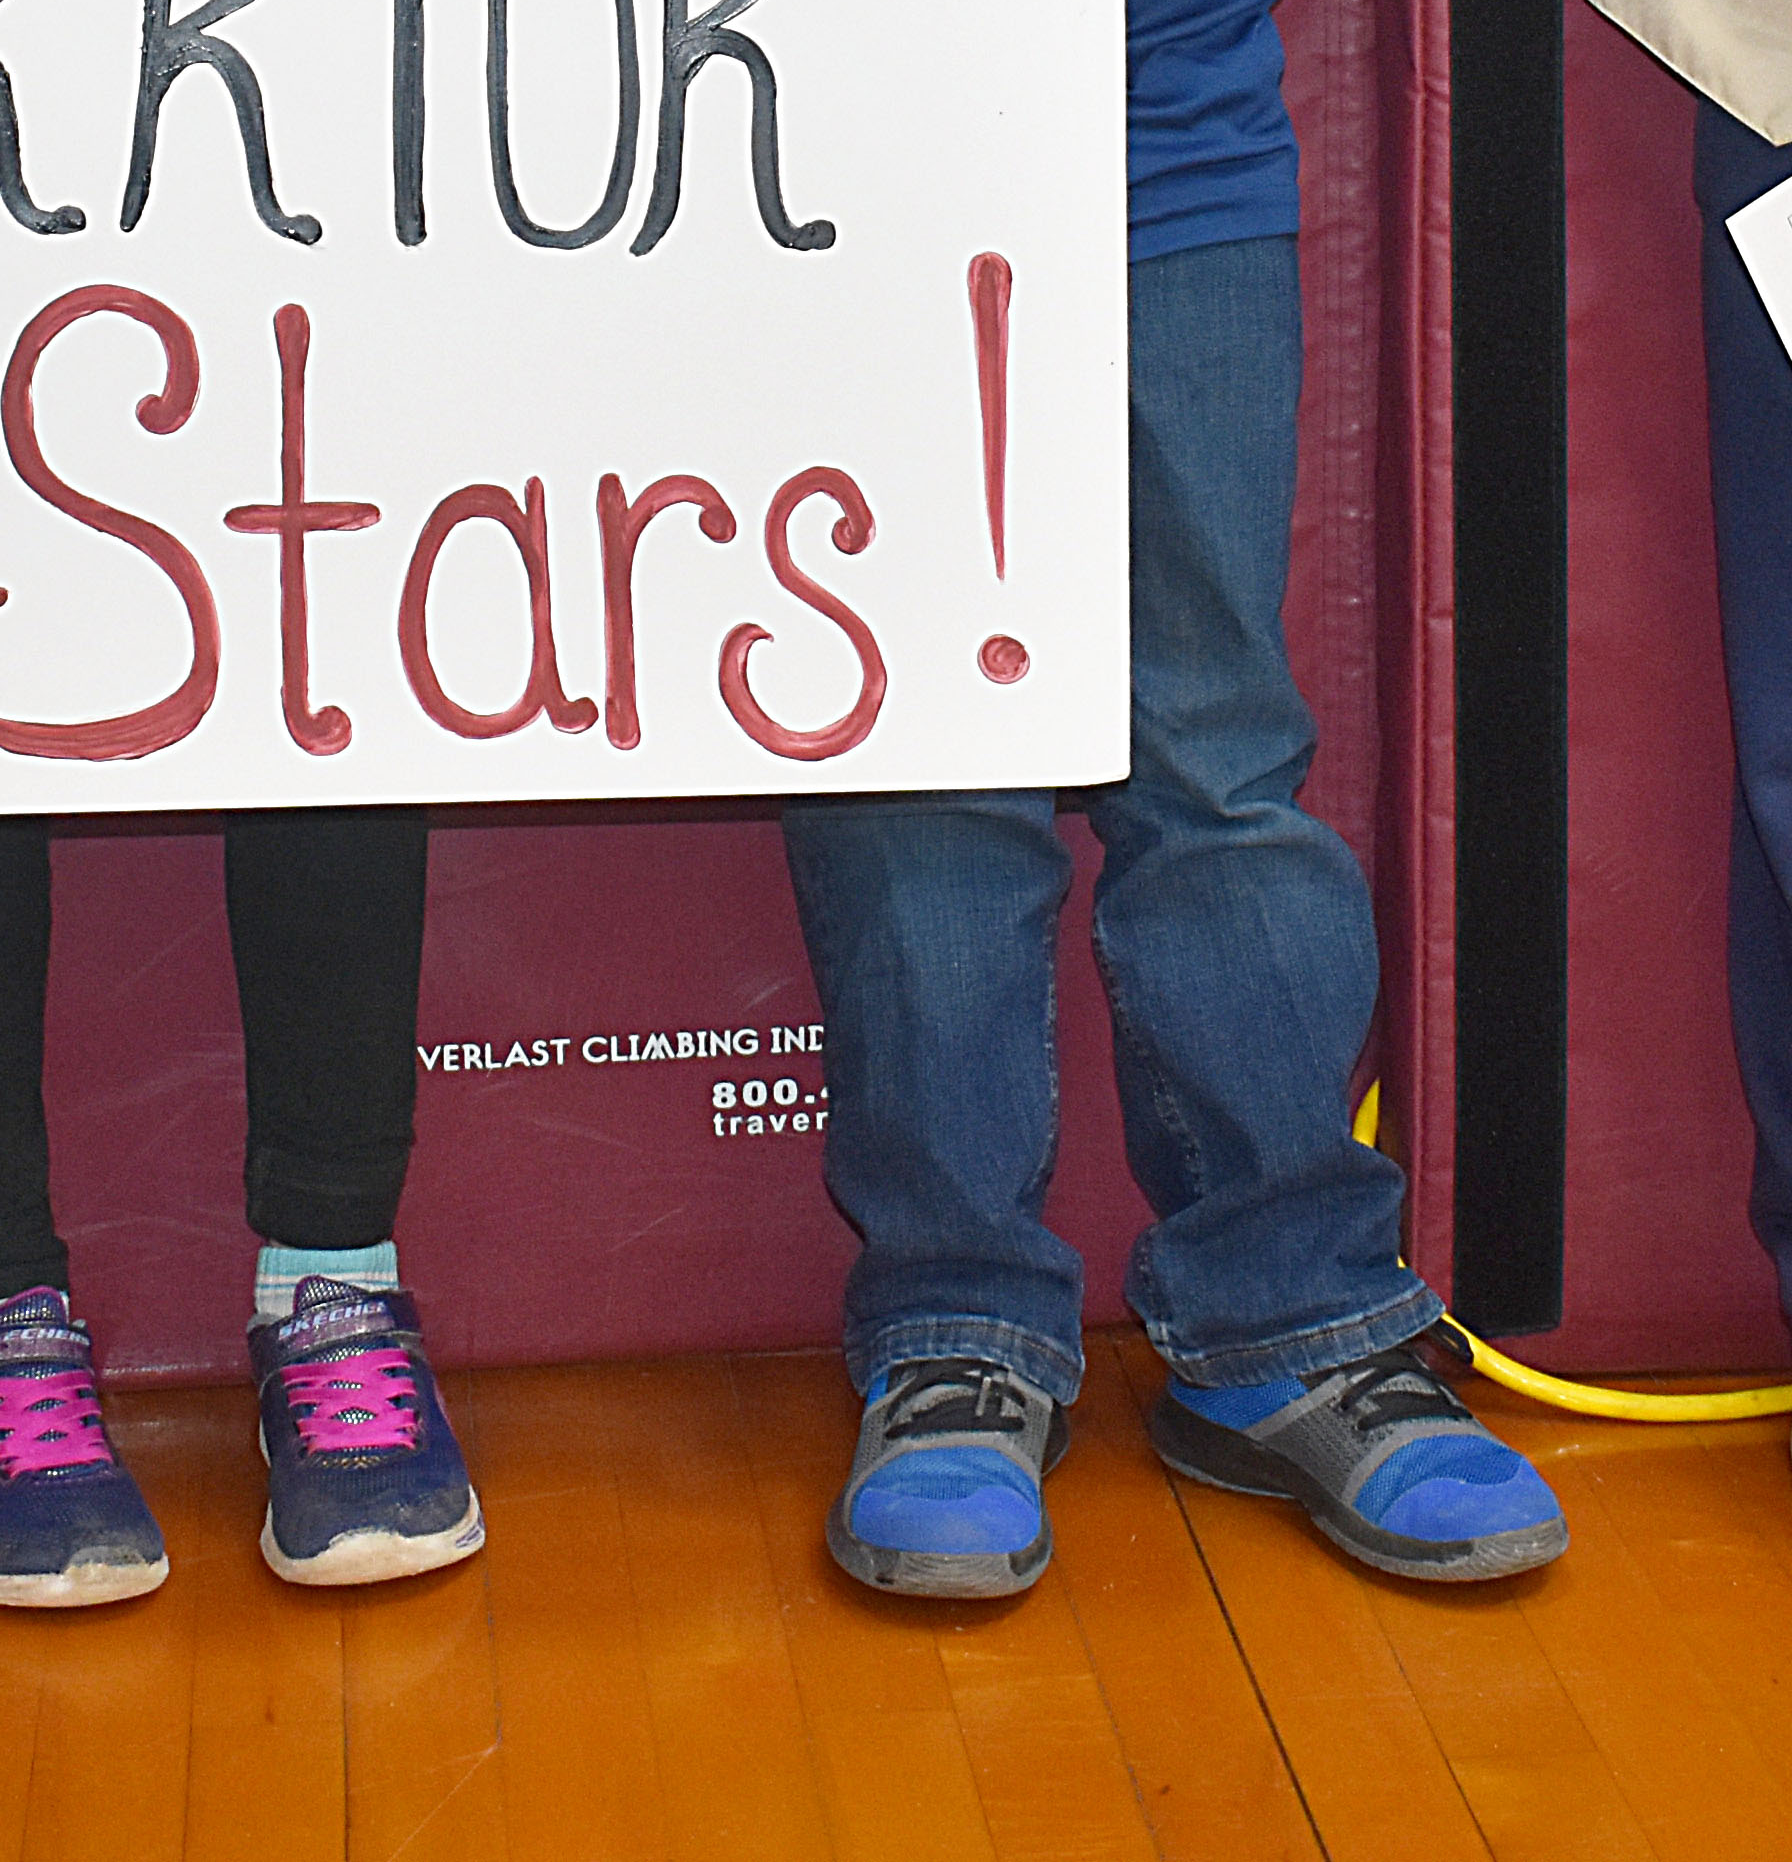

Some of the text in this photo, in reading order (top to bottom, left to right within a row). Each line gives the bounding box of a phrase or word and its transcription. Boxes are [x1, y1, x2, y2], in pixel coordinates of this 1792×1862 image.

[417, 1037, 572, 1072] VERLAST
[581, 1027, 759, 1064] CLIMBING
[713, 1111, 829, 1137] traver
